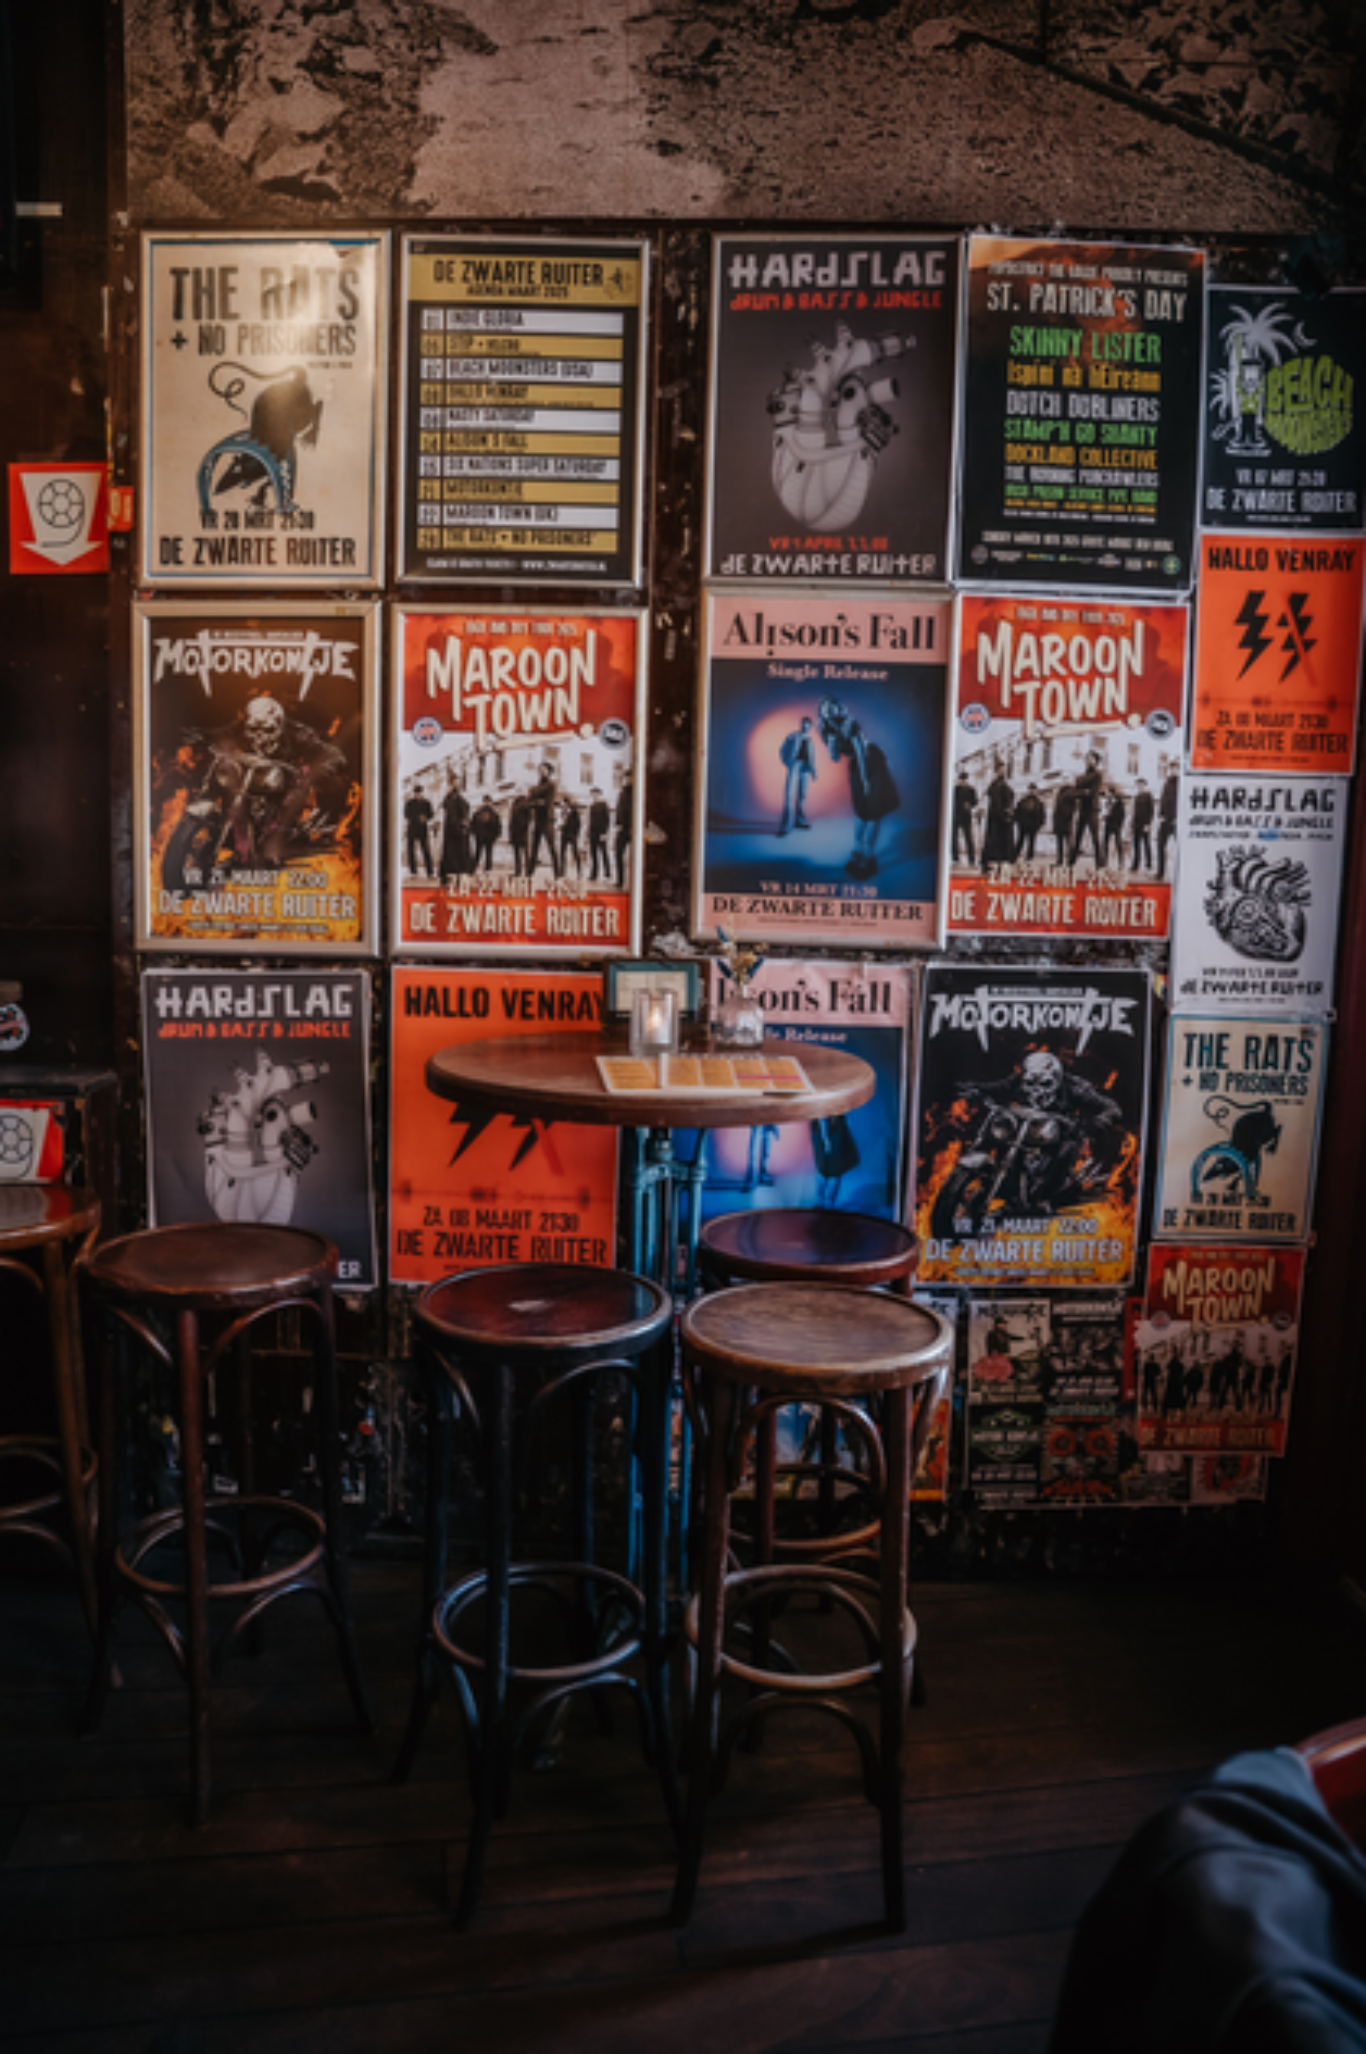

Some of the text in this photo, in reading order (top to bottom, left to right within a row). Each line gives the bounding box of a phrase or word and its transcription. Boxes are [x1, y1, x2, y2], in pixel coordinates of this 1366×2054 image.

[433, 260, 604, 287] DE ZWARTE RUITER
[169, 266, 359, 321] THE RATS
[873, 290, 943, 310] JUNGLE
[987, 282, 1187, 323] ST. PATRICK'S DAY
[198, 325, 226, 356] NO
[236, 325, 357, 356] PRISONERS
[1010, 325, 1161, 363] SKINNY LISTER
[1267, 355, 1354, 412] BEACH
[1006, 390, 1160, 421] DUTCH DUBLINERS
[1080, 446, 1158, 470] COLLECTIVE
[1236, 469, 1252, 485] VR
[1207, 488, 1356, 513] DE ZWARTE RUITER
[159, 537, 357, 567] DE ZWARTE RUITER
[752, 554, 851, 575] ZWARTE
[856, 554, 936, 575] RUITER
[1208, 547, 1356, 571] HALLO VENRAY
[869, 615, 936, 650] Fall
[426, 630, 597, 722] MAROON
[766, 663, 889, 682] Single Release
[977, 619, 1145, 708] MAROON
[1197, 729, 1349, 754] DE ZWARTE RUITER
[183, 868, 202, 885] VR
[231, 869, 279, 887] MAART
[759, 880, 781, 894] VR
[804, 883, 838, 896] MRT
[158, 889, 356, 920] DE ZWARTE RUITER
[712, 897, 923, 920] DE ZWARTE RUITER
[950, 889, 1157, 927] DE ZWARTE RUITER
[409, 902, 620, 937] DE ZWARTE RUITER
[404, 985, 490, 1018] HALLO
[827, 979, 892, 1014] Fall
[288, 1020, 351, 1039] JUNGLE
[1184, 1033, 1314, 1073] THE RATS
[1199, 1072, 1219, 1092] NO
[1226, 1072, 1308, 1096] PRISONERS
[423, 1206, 532, 1231] ZA MAART
[953, 1218, 972, 1234] VR
[1003, 1219, 1050, 1234] MAART
[1163, 1209, 1297, 1232] DE ZWARTE RUITER
[397, 1229, 608, 1264] DE ZWARTE RUITER
[925, 1239, 1122, 1262] DE ZWARTE RUITER
[1163, 1255, 1276, 1316] MAROON
